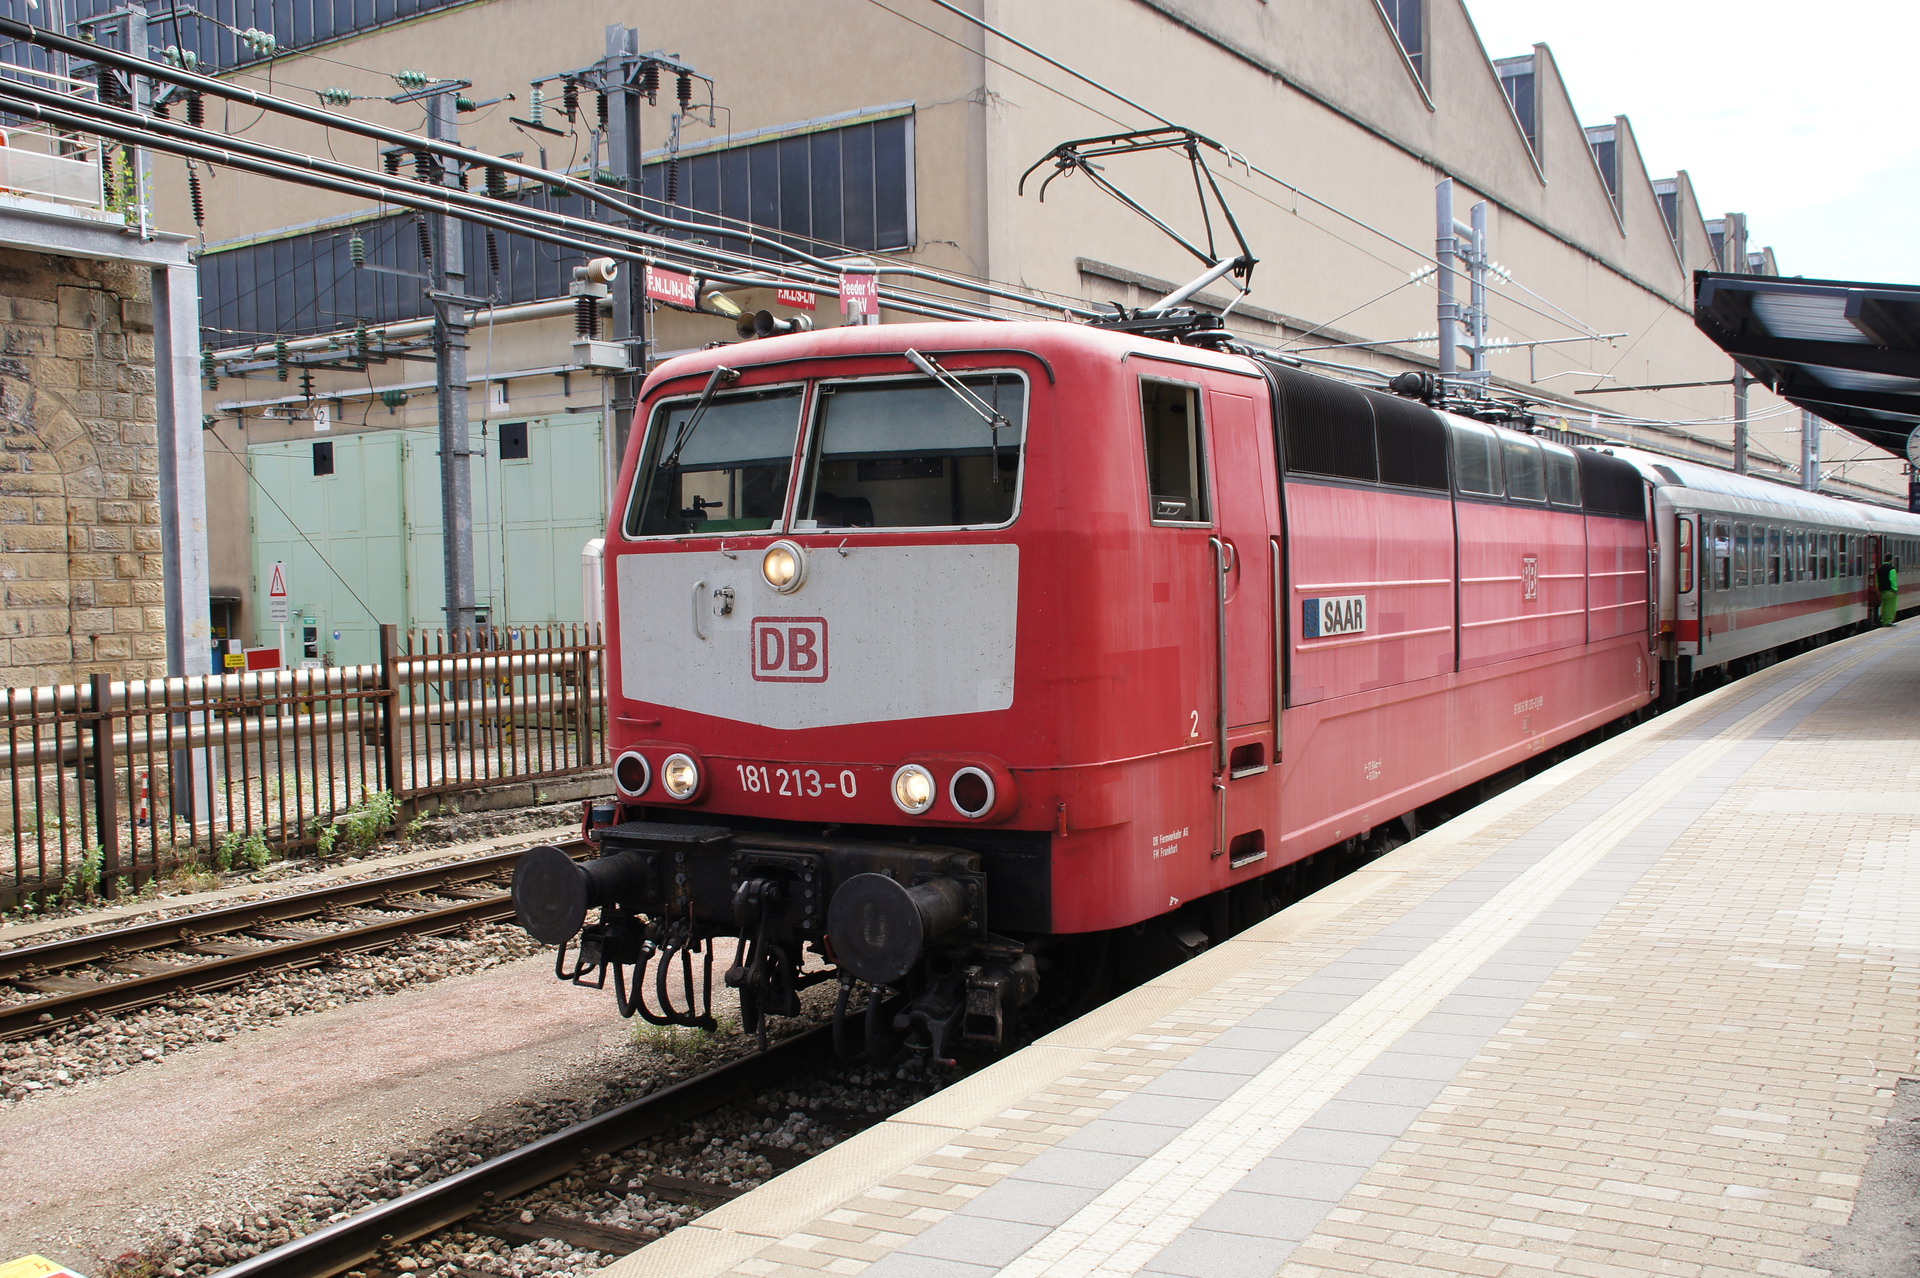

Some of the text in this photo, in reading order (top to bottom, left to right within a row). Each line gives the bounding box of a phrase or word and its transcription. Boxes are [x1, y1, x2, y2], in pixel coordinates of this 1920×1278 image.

[842, 280, 876, 296] Feeder 14
[319, 410, 325, 424] 2
[1324, 599, 1363, 633] SAAR
[758, 625, 819, 672] DB
[1190, 709, 1199, 738] 2
[736, 764, 858, 798] 181 213-0
[1160, 843, 1178, 858] Frankfurt
